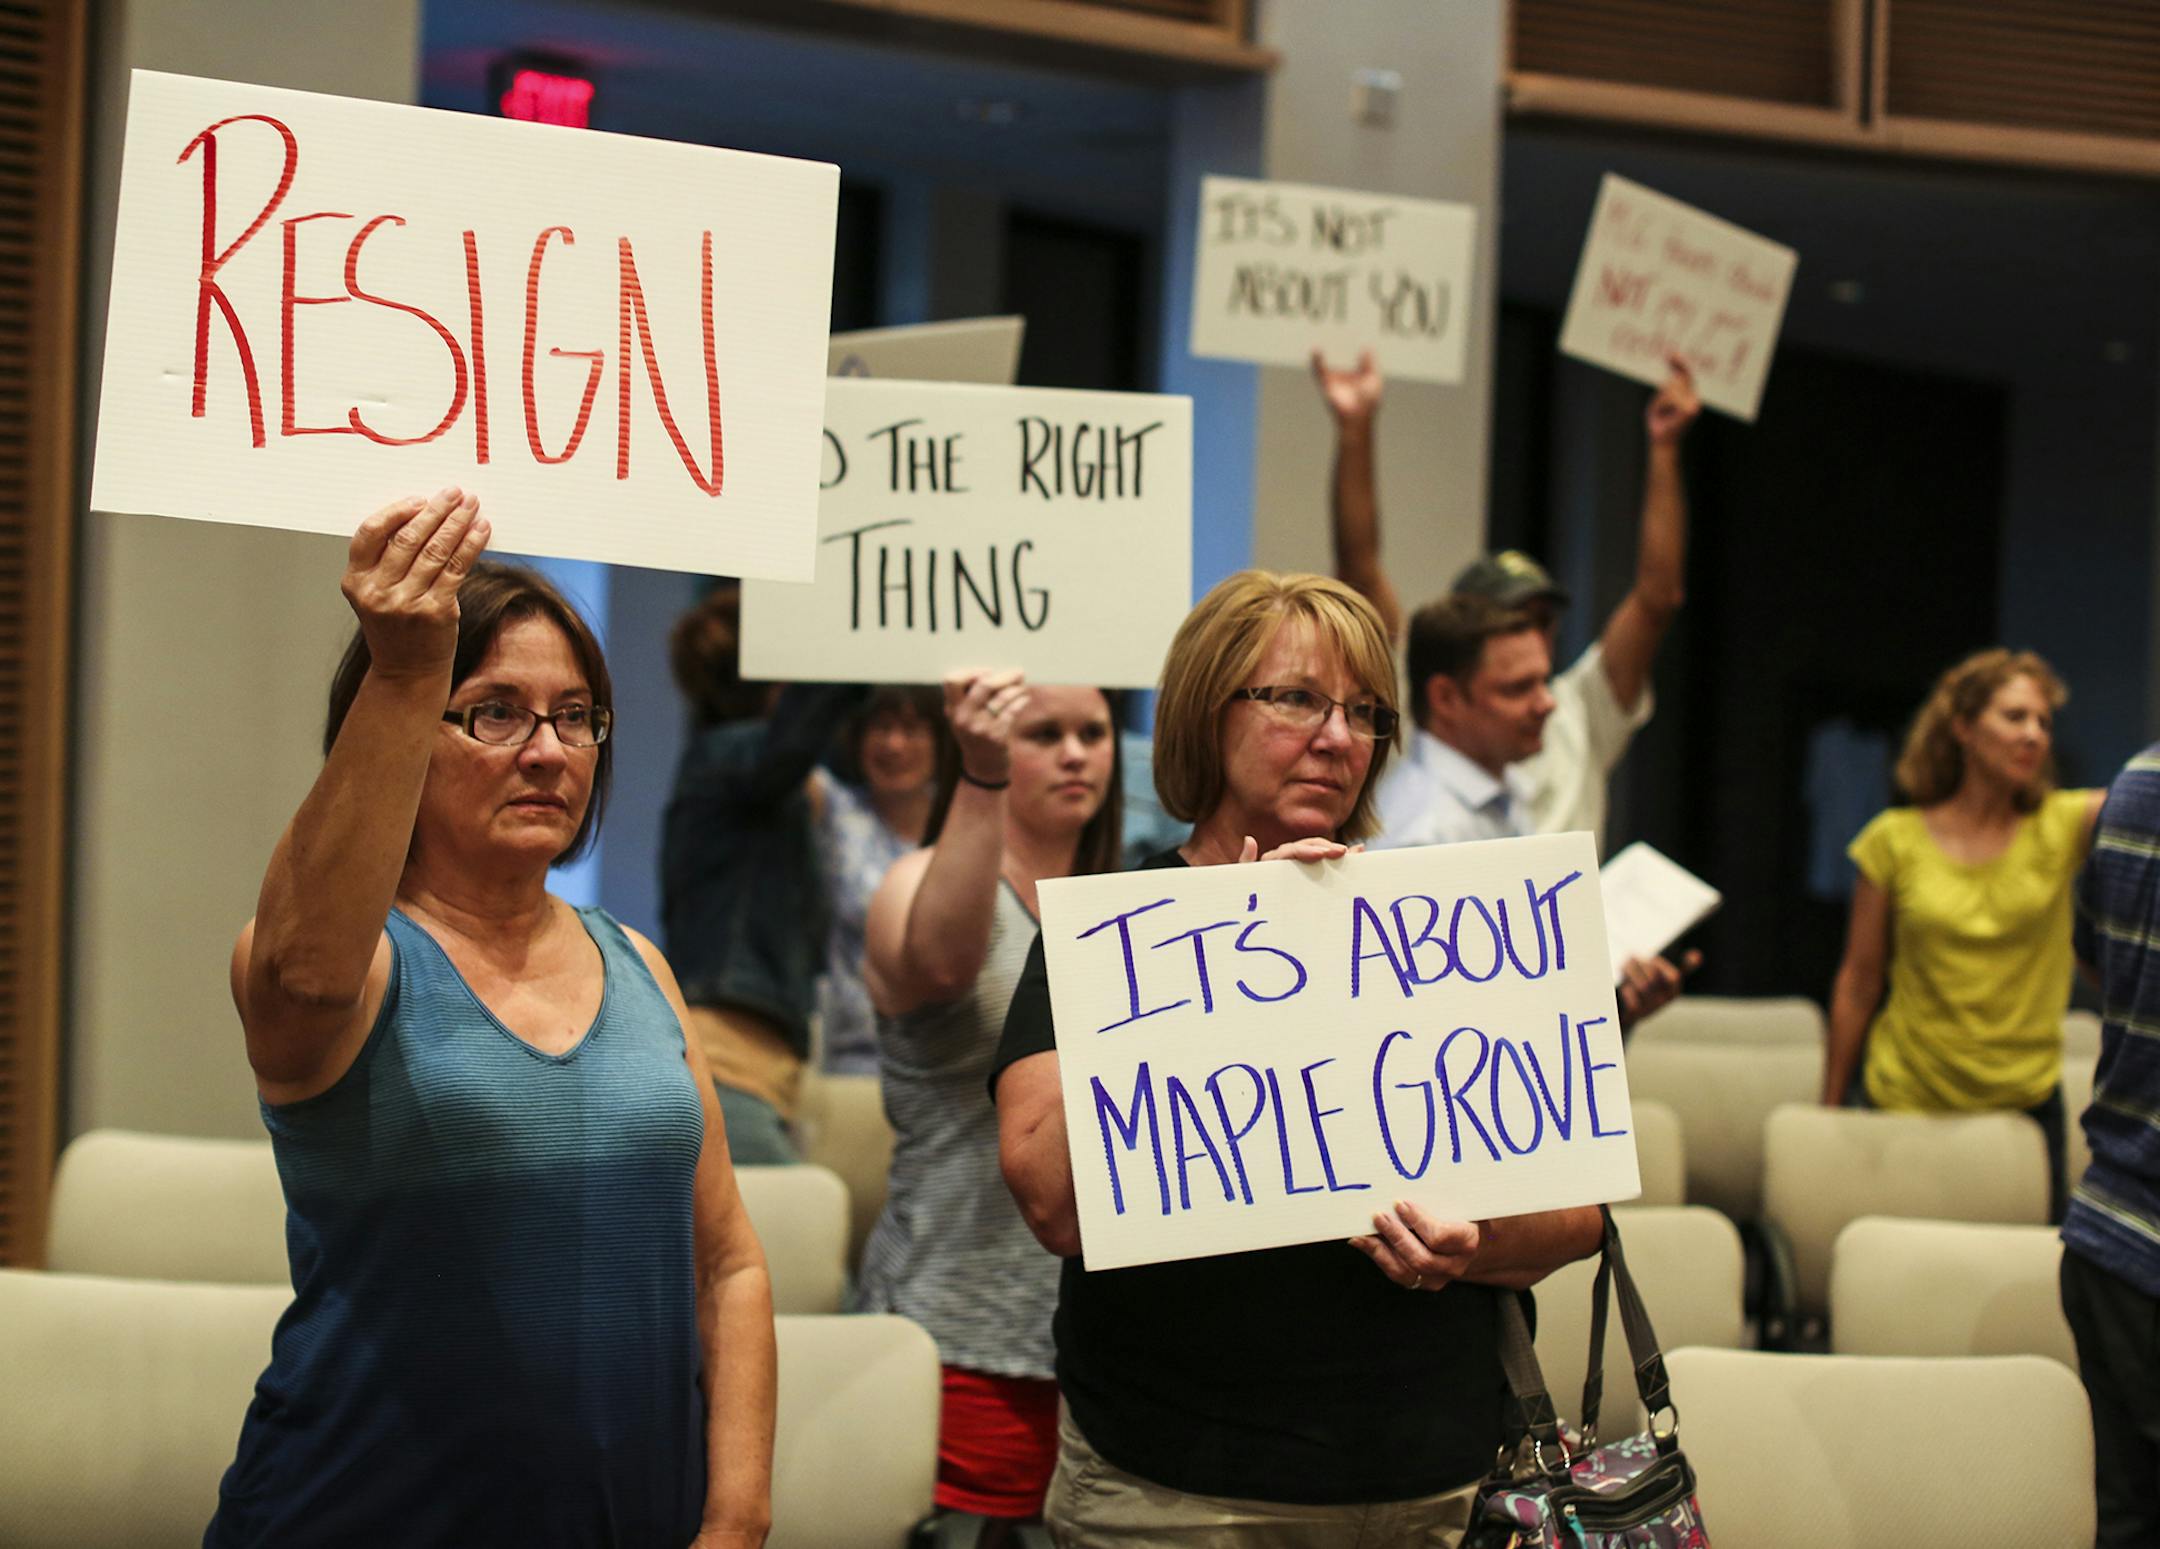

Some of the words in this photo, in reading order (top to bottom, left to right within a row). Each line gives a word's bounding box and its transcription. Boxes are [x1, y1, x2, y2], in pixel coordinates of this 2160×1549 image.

[1311, 204, 1396, 255] NOT
[177, 114, 723, 497] RESIGN
[1227, 260, 1356, 325] ABOUT
[1367, 268, 1451, 339] YOU
[866, 418, 969, 493] THE
[1017, 416, 1164, 501] RIGHT
[822, 519, 1050, 633] THING
[1076, 893, 1307, 1033] IT'S
[1351, 871, 1582, 999] ABOUT
[1089, 1058, 1371, 1215] MAPLE
[1373, 1013, 1628, 1180] GROVE
